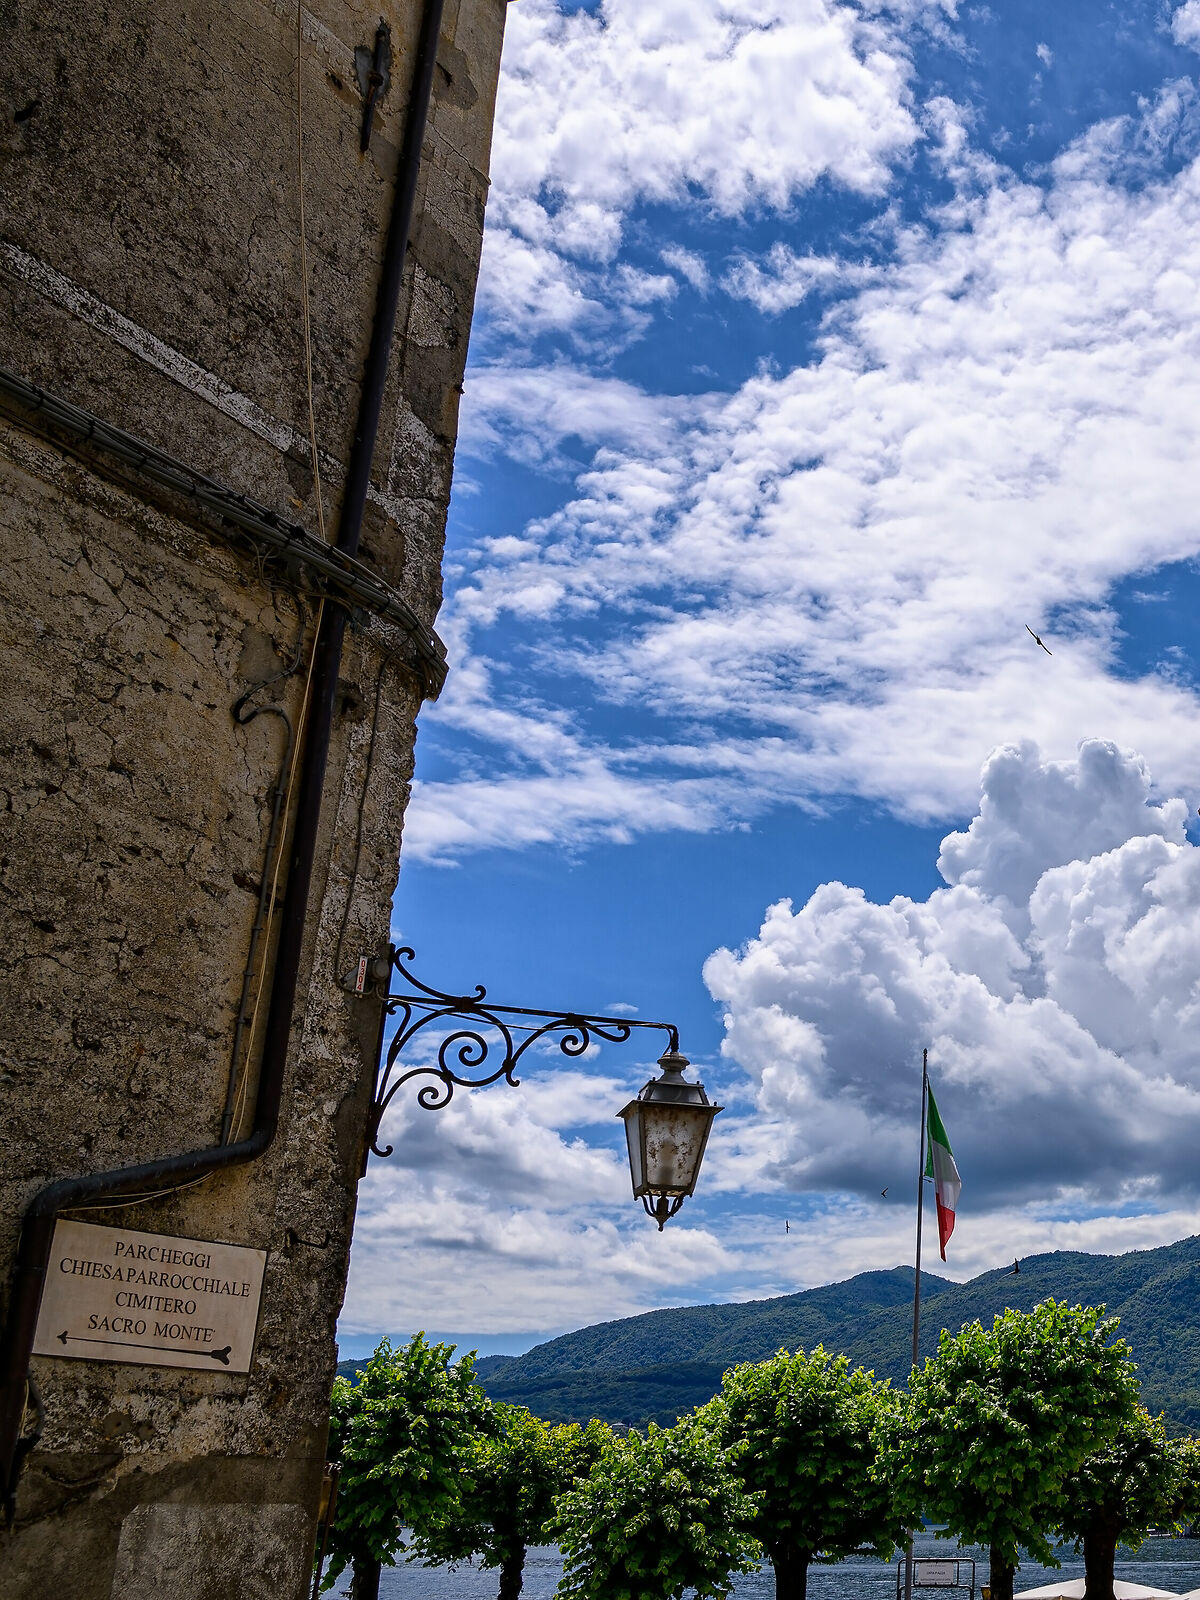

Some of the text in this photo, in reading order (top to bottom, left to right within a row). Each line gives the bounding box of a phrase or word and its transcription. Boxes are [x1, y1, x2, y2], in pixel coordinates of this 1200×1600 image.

[357, 960, 366, 990] 0304
[114, 1241, 211, 1269] PARCHEGGI
[60, 1257, 251, 1298] CHIESA PARROCCHIALE
[115, 1291, 197, 1315] CIMITERO
[87, 1314, 215, 1343] SACRO MONTE
